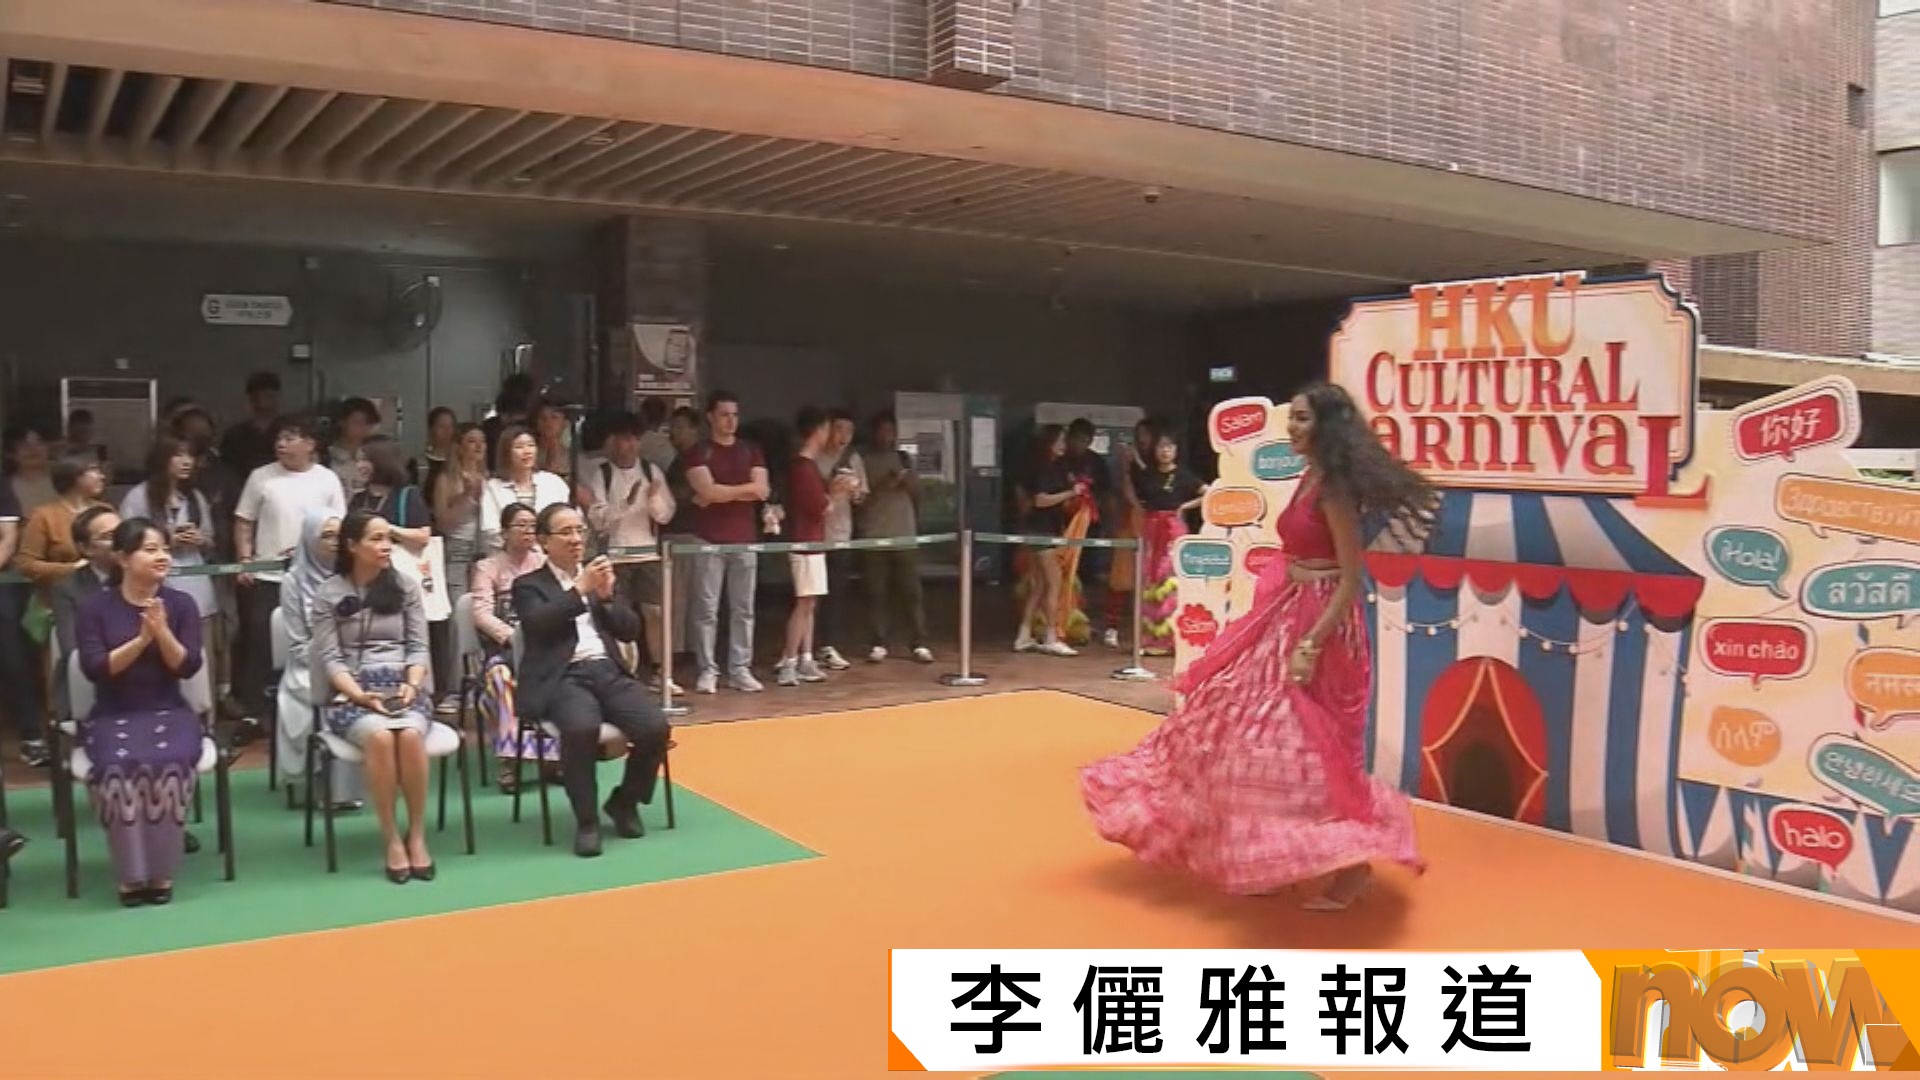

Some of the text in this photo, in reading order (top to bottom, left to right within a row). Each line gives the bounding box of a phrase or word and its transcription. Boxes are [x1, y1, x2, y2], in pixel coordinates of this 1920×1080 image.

[1411, 274, 1583, 360] HKU
[1366, 341, 1639, 413] CULTURAL
[1760, 407, 1821, 447] 你好
[1828, 571, 1912, 605] สวัสดี
[1713, 639, 1745, 657] xin
[1782, 818, 1845, 848] halo
